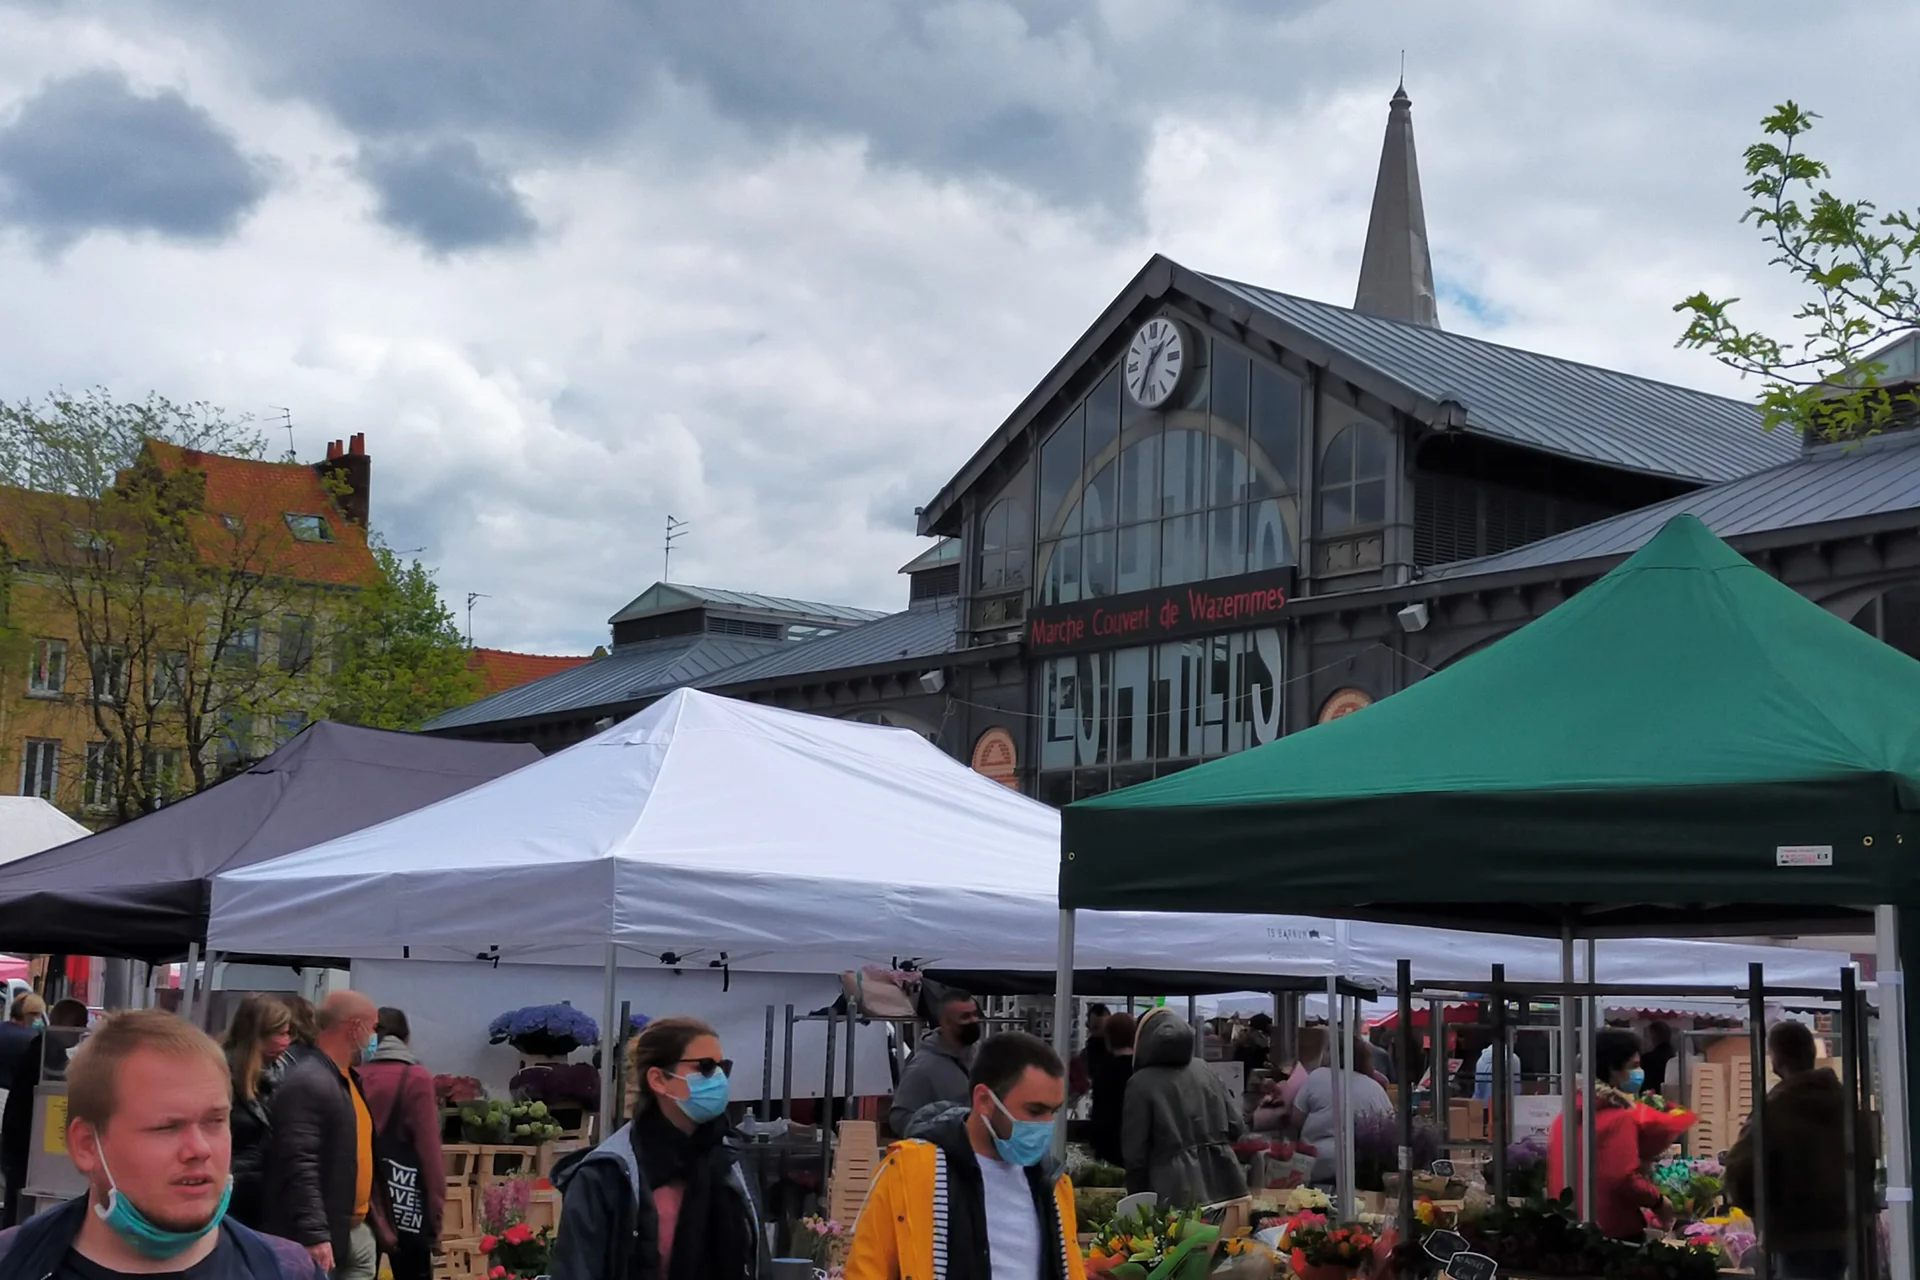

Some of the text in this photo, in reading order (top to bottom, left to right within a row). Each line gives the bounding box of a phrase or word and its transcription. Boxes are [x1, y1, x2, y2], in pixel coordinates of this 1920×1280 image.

[1031, 586, 1285, 646] Marché Couvert de Wazemmes
[392, 1167, 417, 1186] WE
